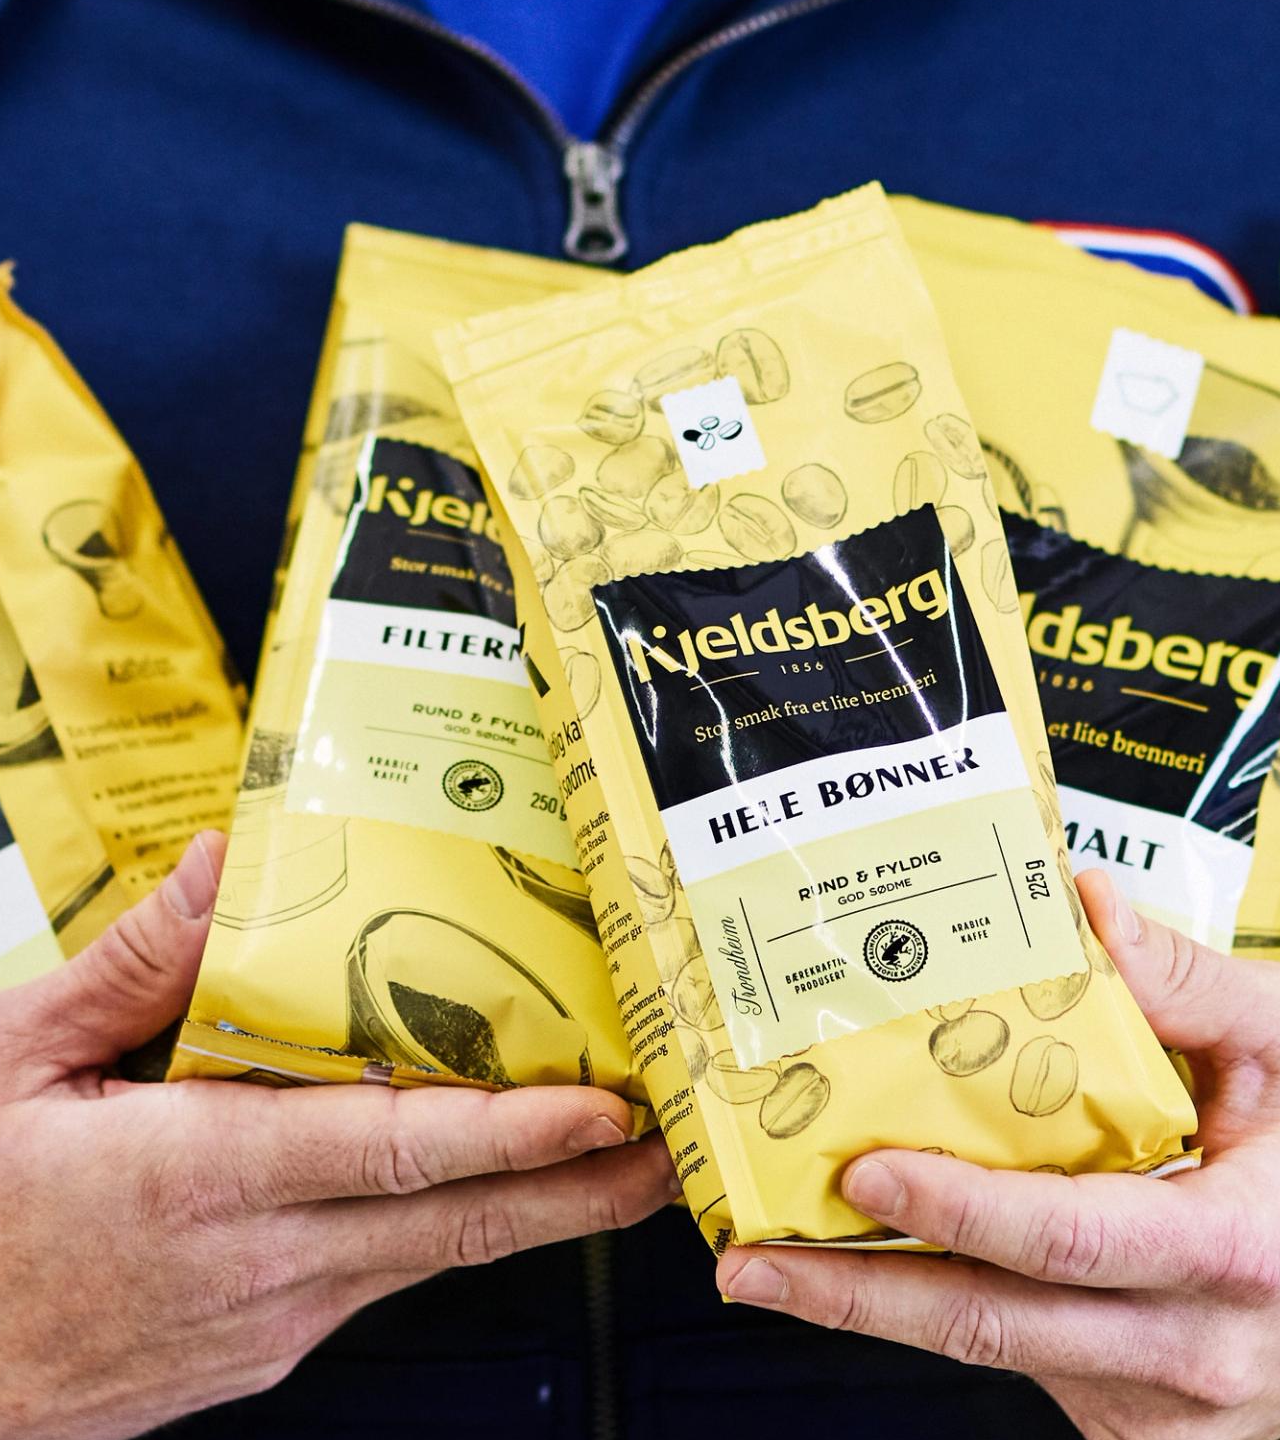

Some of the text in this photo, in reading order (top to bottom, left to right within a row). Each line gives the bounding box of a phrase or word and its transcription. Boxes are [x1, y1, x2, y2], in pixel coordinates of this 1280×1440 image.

[625, 568, 950, 684] Kjeldsberg
[780, 660, 824, 676] 1856
[412, 703, 464, 721] RUND
[734, 704, 783, 731] smak
[784, 701, 810, 717] fra
[812, 699, 830, 713] et
[830, 694, 860, 711] lite
[1047, 721, 1207, 775] et lite brenneri
[373, 770, 410, 785] KAFFE
[530, 791, 558, 815] 250
[708, 746, 981, 845] HELE BØNNER
[798, 850, 943, 903] RUND & FYLDIG
[1025, 871, 1051, 901] 225
[837, 877, 913, 906] GOD SØDME
[951, 916, 991, 934] ARABICA
[960, 929, 989, 944] KAFFE
[718, 916, 763, 1016] Trondheim
[794, 969, 846, 994] PRODUSERT
